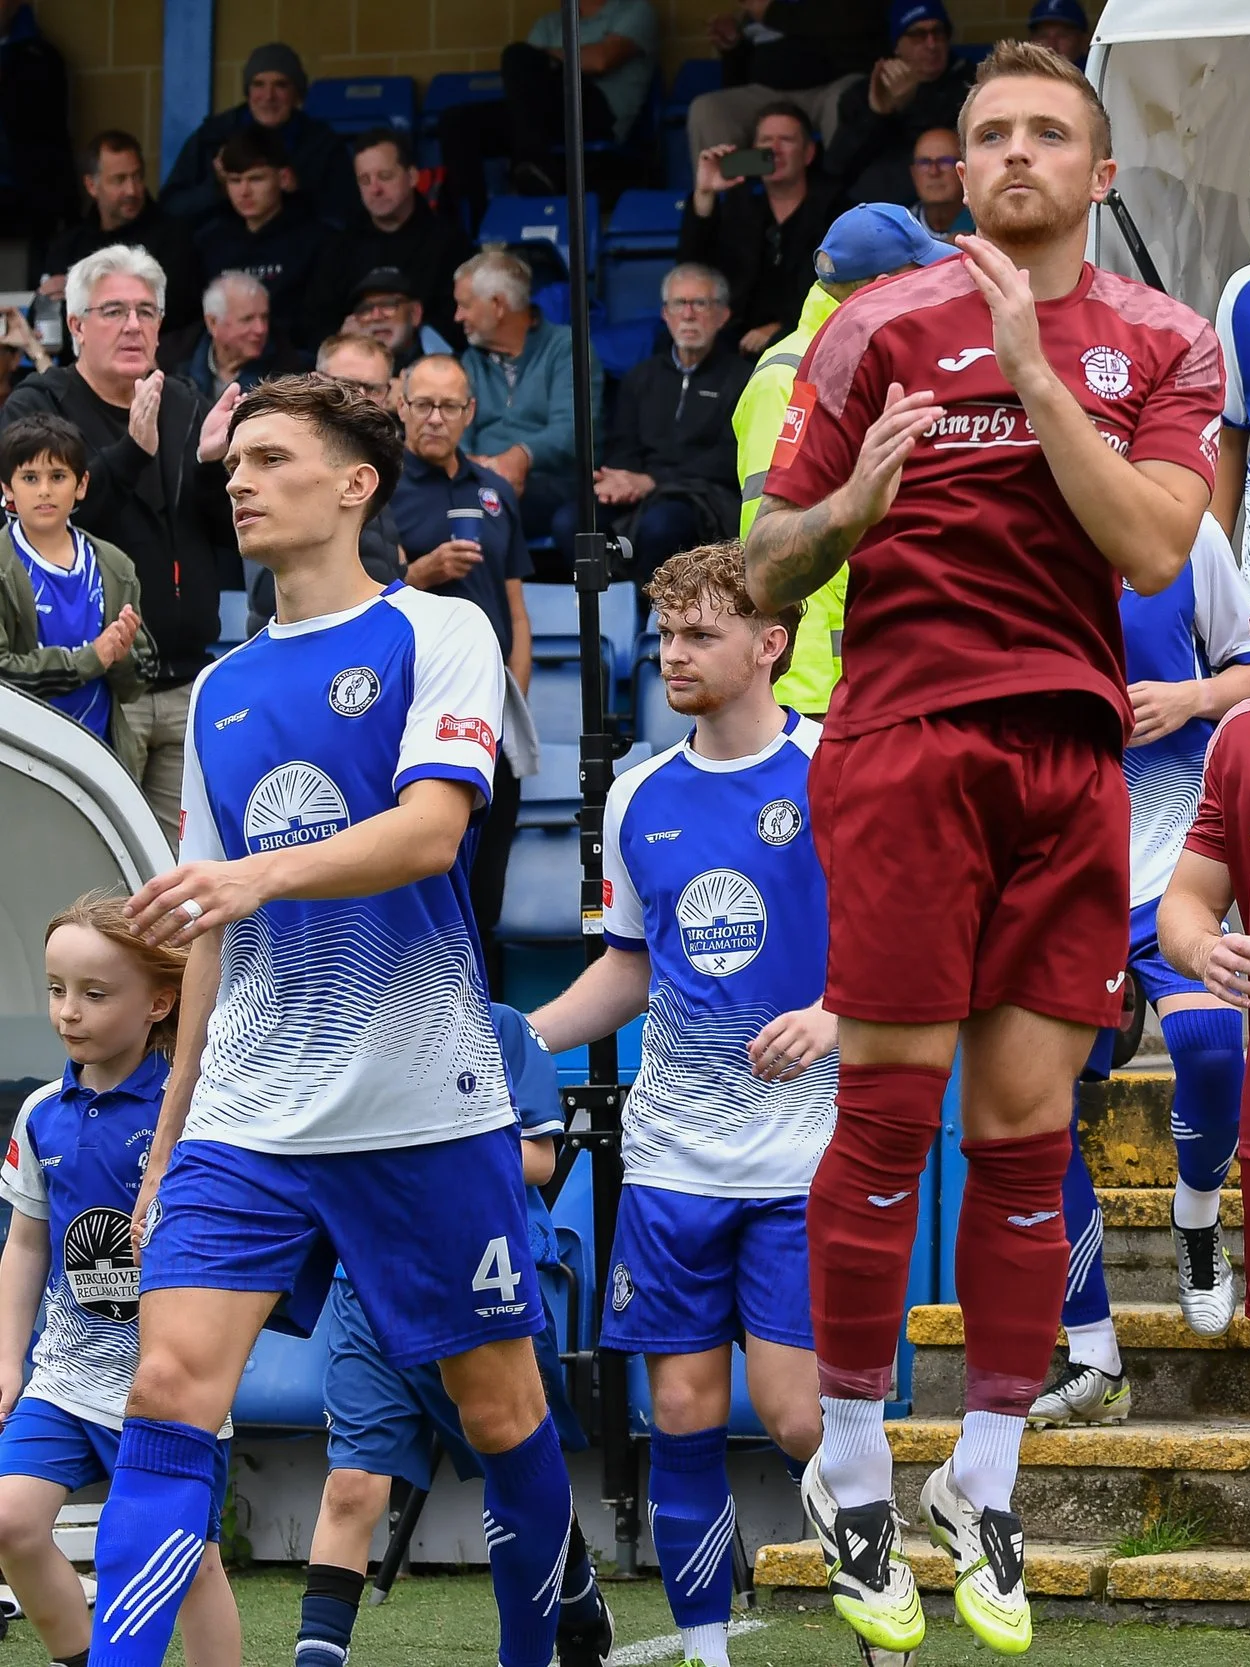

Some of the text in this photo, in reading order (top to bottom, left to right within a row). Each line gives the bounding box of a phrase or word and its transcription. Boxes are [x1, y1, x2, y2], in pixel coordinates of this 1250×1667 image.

[1084, 380, 1118, 400] FOOTBALL
[579, 771, 586, 781] C
[258, 823, 339, 852] BIRCHOVER
[593, 844, 601, 853] D
[686, 924, 757, 942] BIRCHOVER
[689, 936, 757, 952] RECLAMATION
[472, 1236, 521, 1301] 4
[74, 1271, 140, 1286] BIRCHOVE
[77, 1285, 140, 1298] RECLAMATIO
